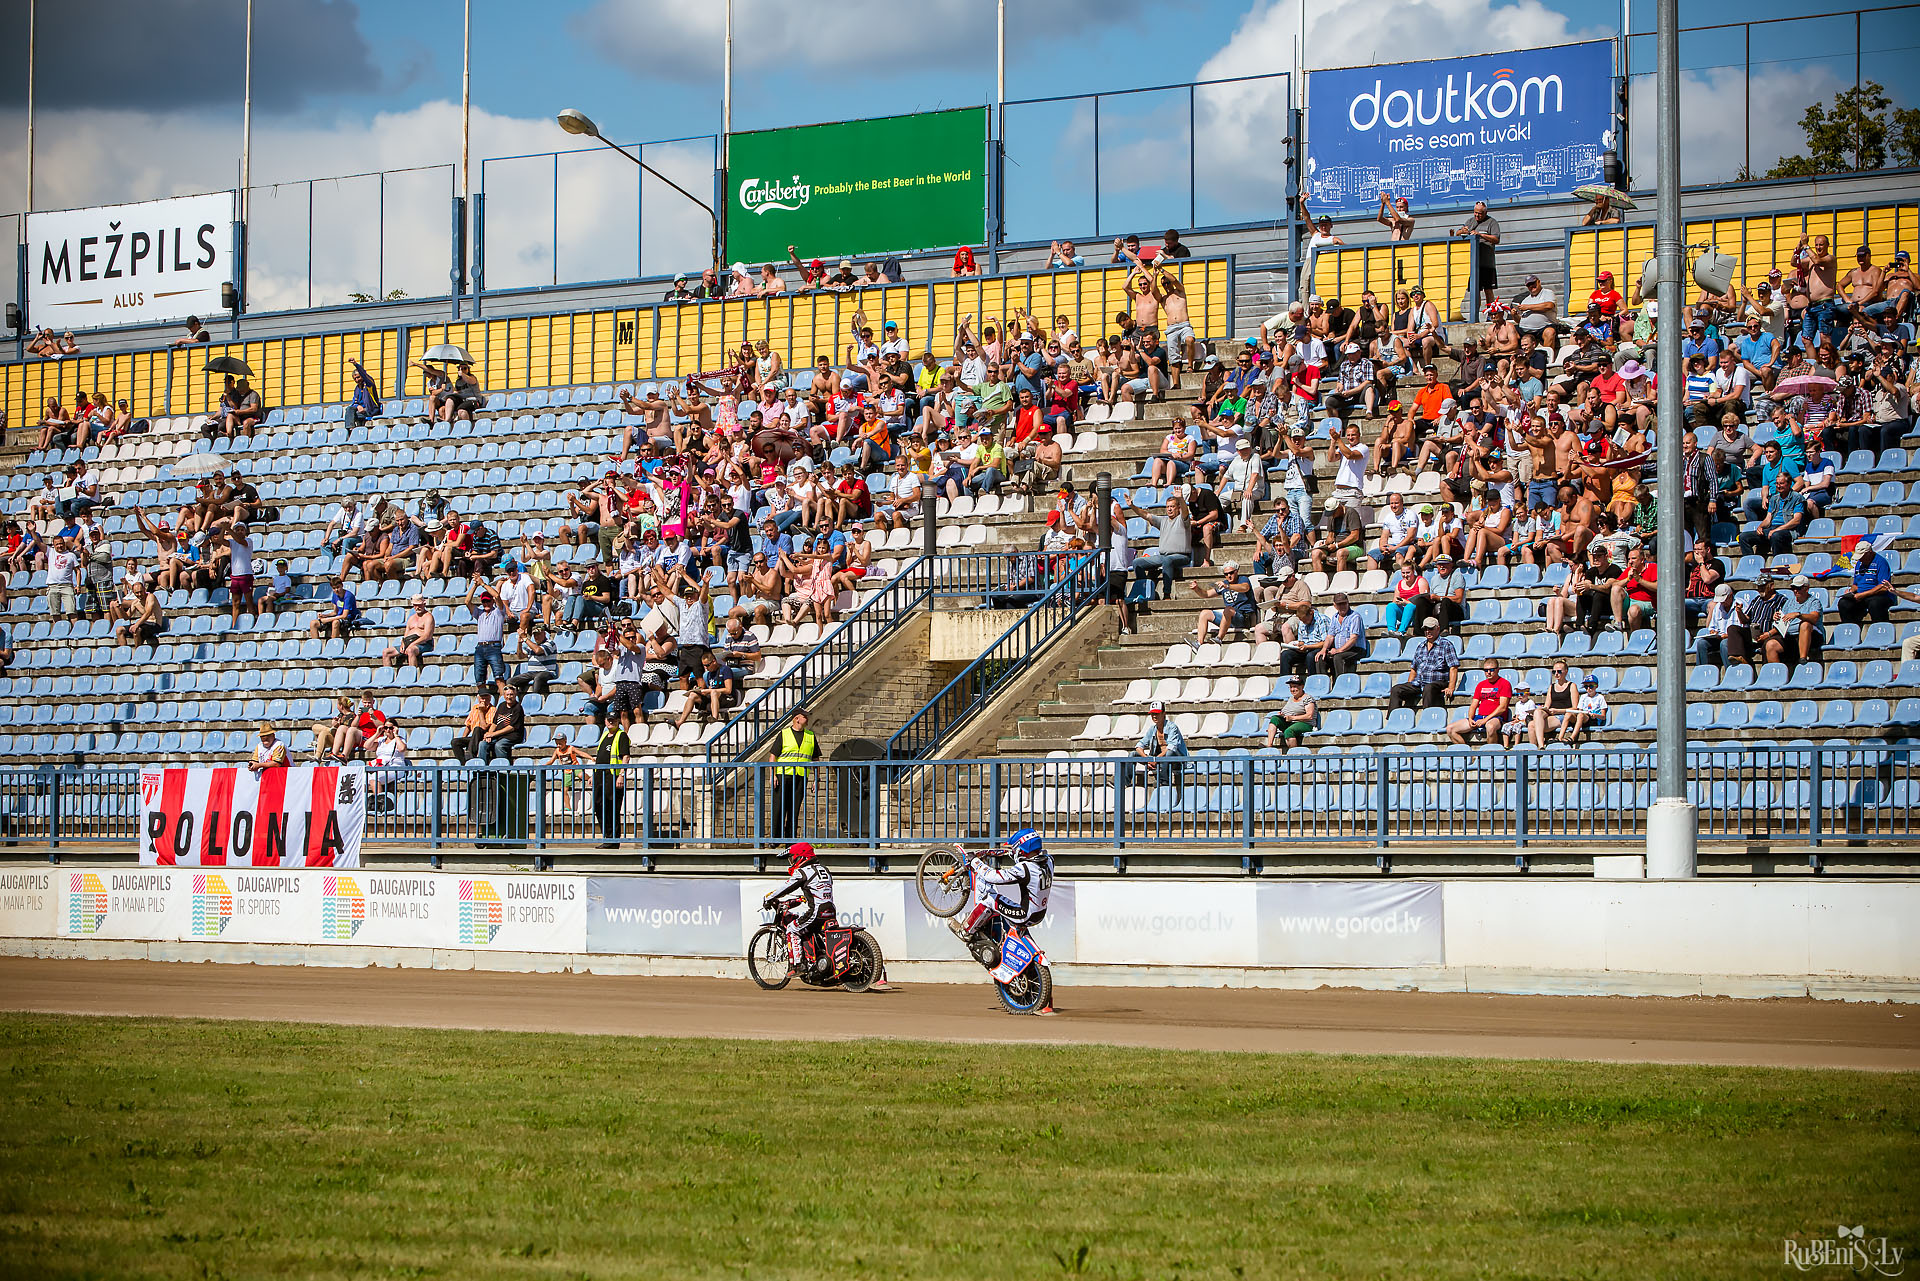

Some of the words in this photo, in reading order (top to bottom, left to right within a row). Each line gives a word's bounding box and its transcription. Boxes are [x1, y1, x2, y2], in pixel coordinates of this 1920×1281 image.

[1388, 134, 1424, 153] mēs
[1429, 131, 1474, 149] esam
[1479, 121, 1532, 144] tuvāk!
[814, 180, 853, 196] Probably
[855, 180, 870, 192] the
[871, 178, 891, 190] Best
[893, 177, 914, 188] Beer
[916, 175, 925, 186] in
[926, 174, 942, 185] the
[943, 170, 971, 183] World
[739, 177, 811, 214] Carlsberg
[41, 221, 216, 285] MEŽPILS
[1397, 259, 1407, 285] L
[113, 292, 144, 309] ALUS
[619, 322, 633, 345] M
[148, 810, 345, 858] POLONIA
[112, 874, 171, 892] DAUGAVPILS
[238, 876, 300, 894] DAUGAVPILS
[370, 879, 435, 897] DAUGAVPILS
[507, 883, 575, 901] DAUGAVPILS
[3, 895, 25, 911] MANA
[27, 895, 43, 911] PILS
[111, 896, 120, 912] IR
[122, 896, 146, 913] MANA
[148, 897, 165, 913] PILS
[236, 898, 246, 914] IR
[248, 898, 280, 915] SPORTS
[370, 902, 378, 918] IR
[381, 902, 408, 919] MANA
[410, 902, 429, 920] PILS
[507, 906, 517, 923] IR
[519, 906, 555, 924] SPORTS
[604, 905, 723, 928] www.gorod.lv
[1097, 911, 1233, 934] www.gorod.lv
[1280, 911, 1422, 938] www.gorod.lv
